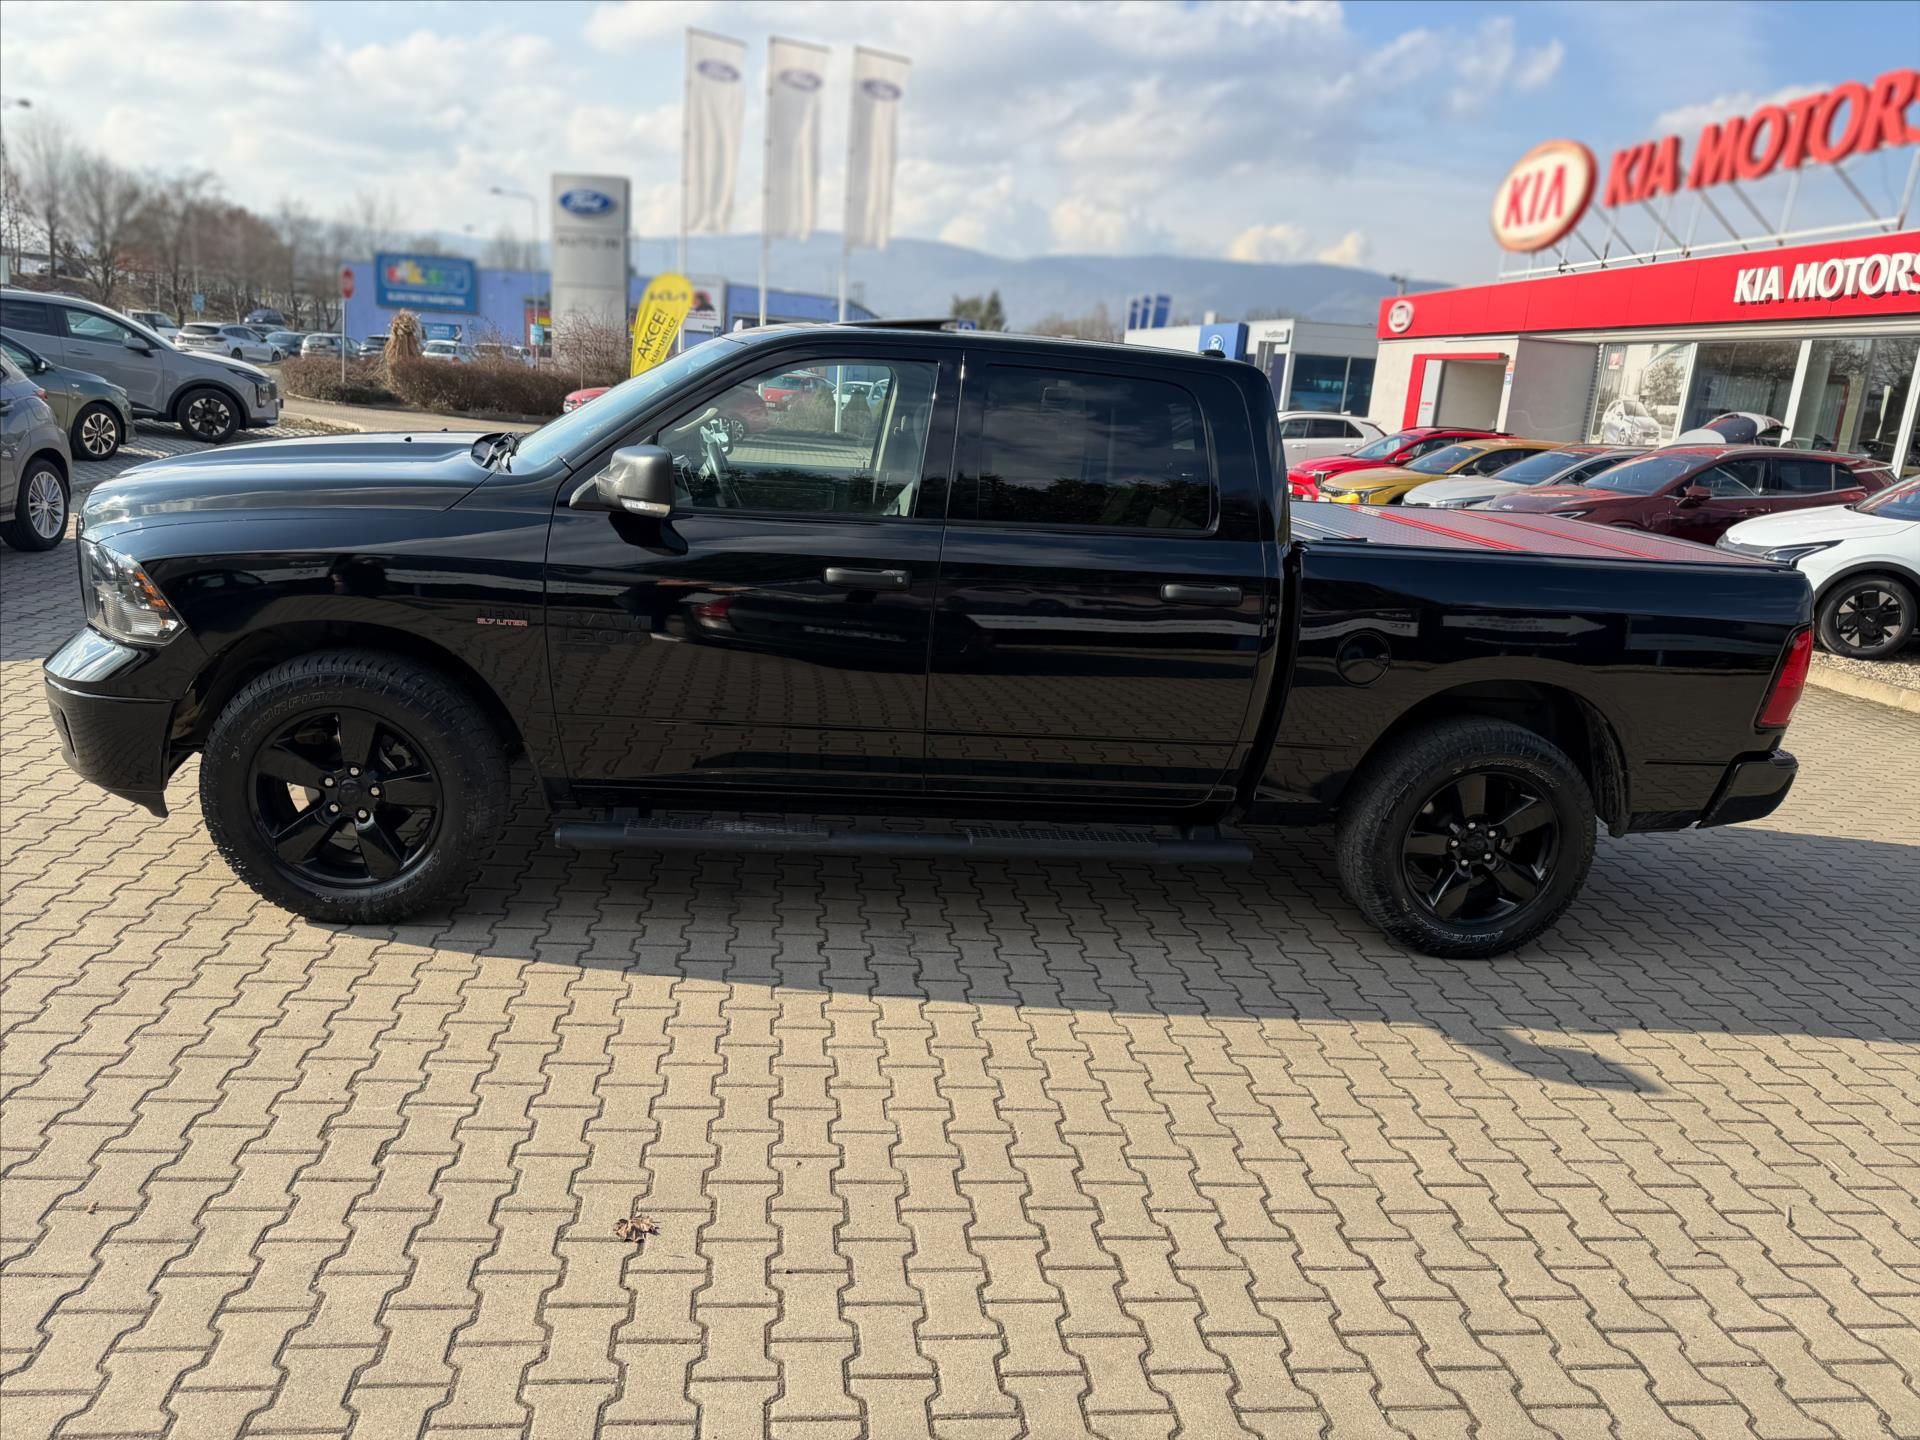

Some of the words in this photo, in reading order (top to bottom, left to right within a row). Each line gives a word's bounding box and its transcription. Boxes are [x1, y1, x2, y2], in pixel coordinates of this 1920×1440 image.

[1503, 164, 1566, 229] KIA
[1604, 136, 1682, 207] KIA
[1733, 266, 1783, 303] KIA
[637, 307, 669, 360] AKCE!
